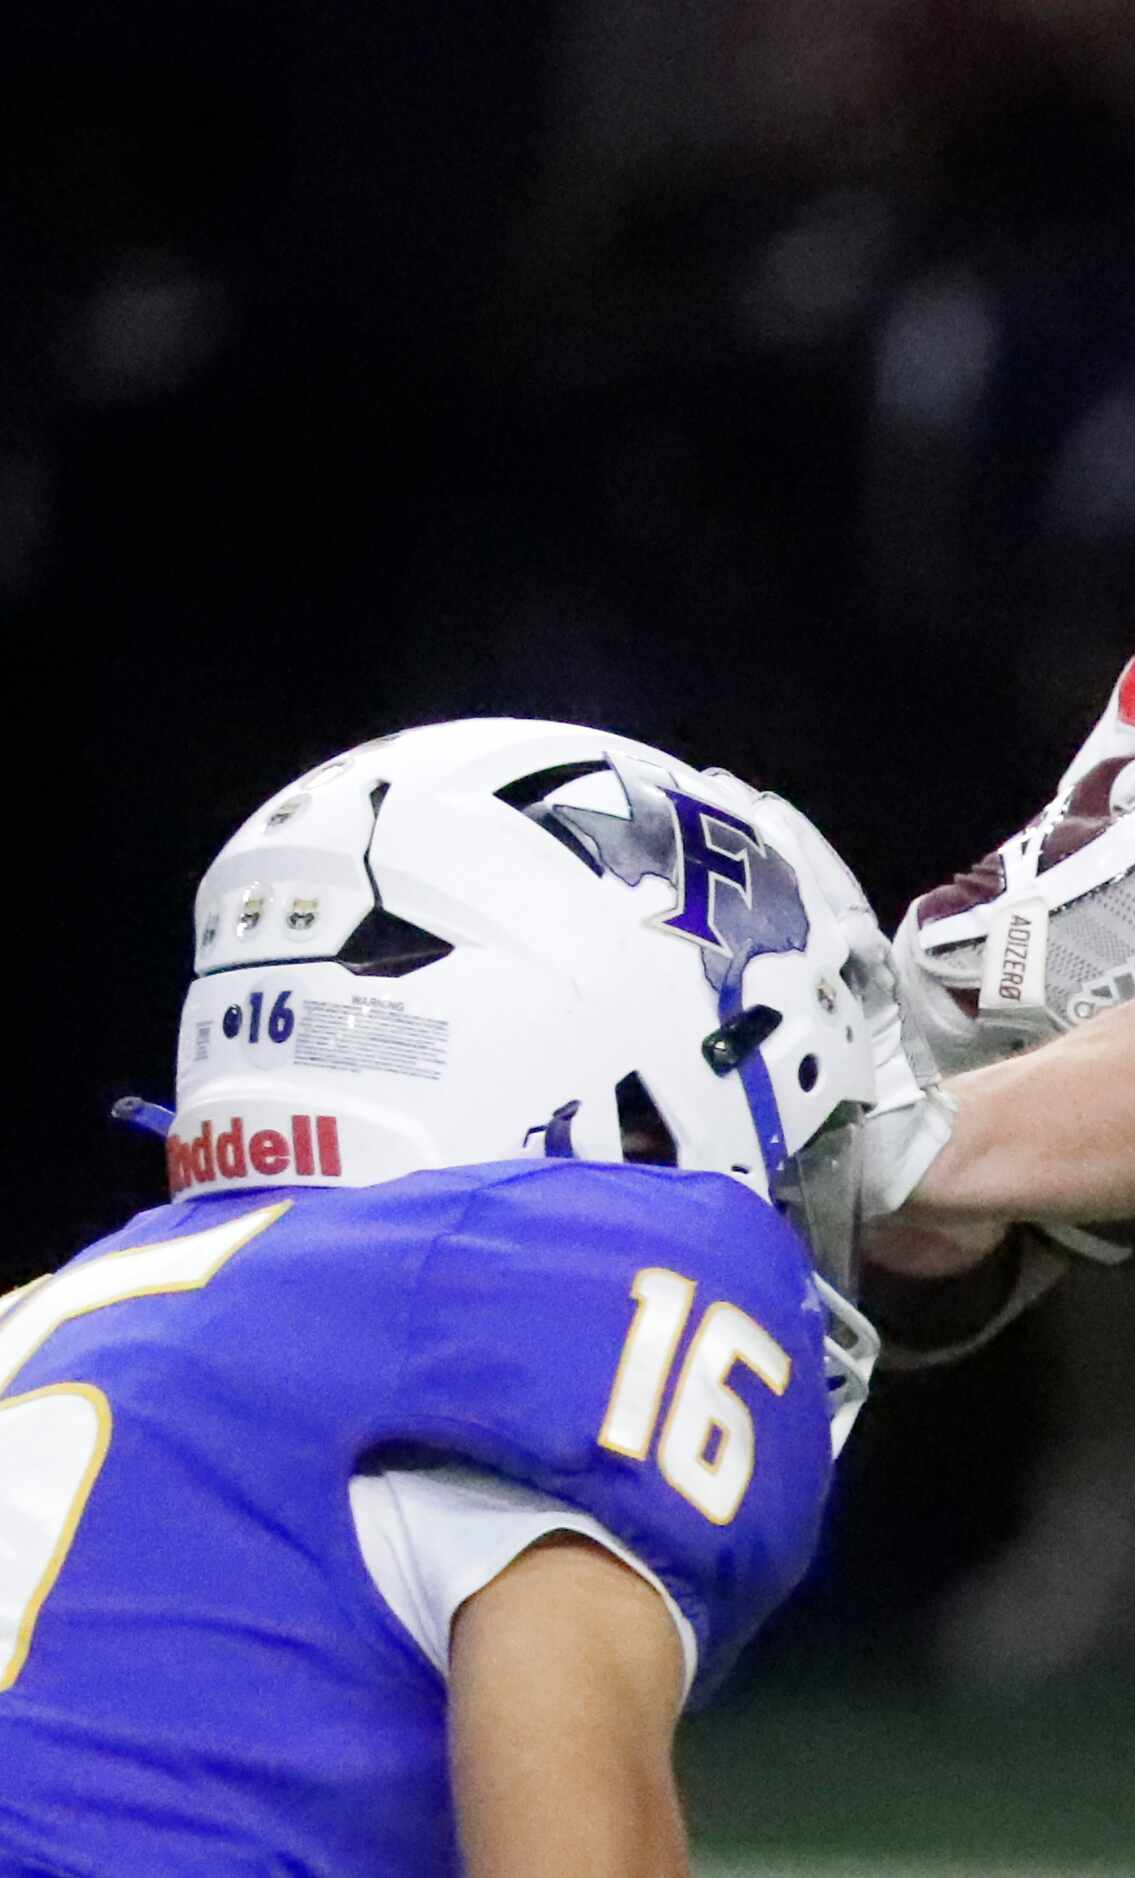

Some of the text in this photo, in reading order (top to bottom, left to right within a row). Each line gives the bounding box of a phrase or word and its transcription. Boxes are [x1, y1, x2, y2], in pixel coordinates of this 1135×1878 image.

[641, 785, 767, 959] F
[247, 990, 295, 1044] 16
[597, 1266, 792, 1525] 16
